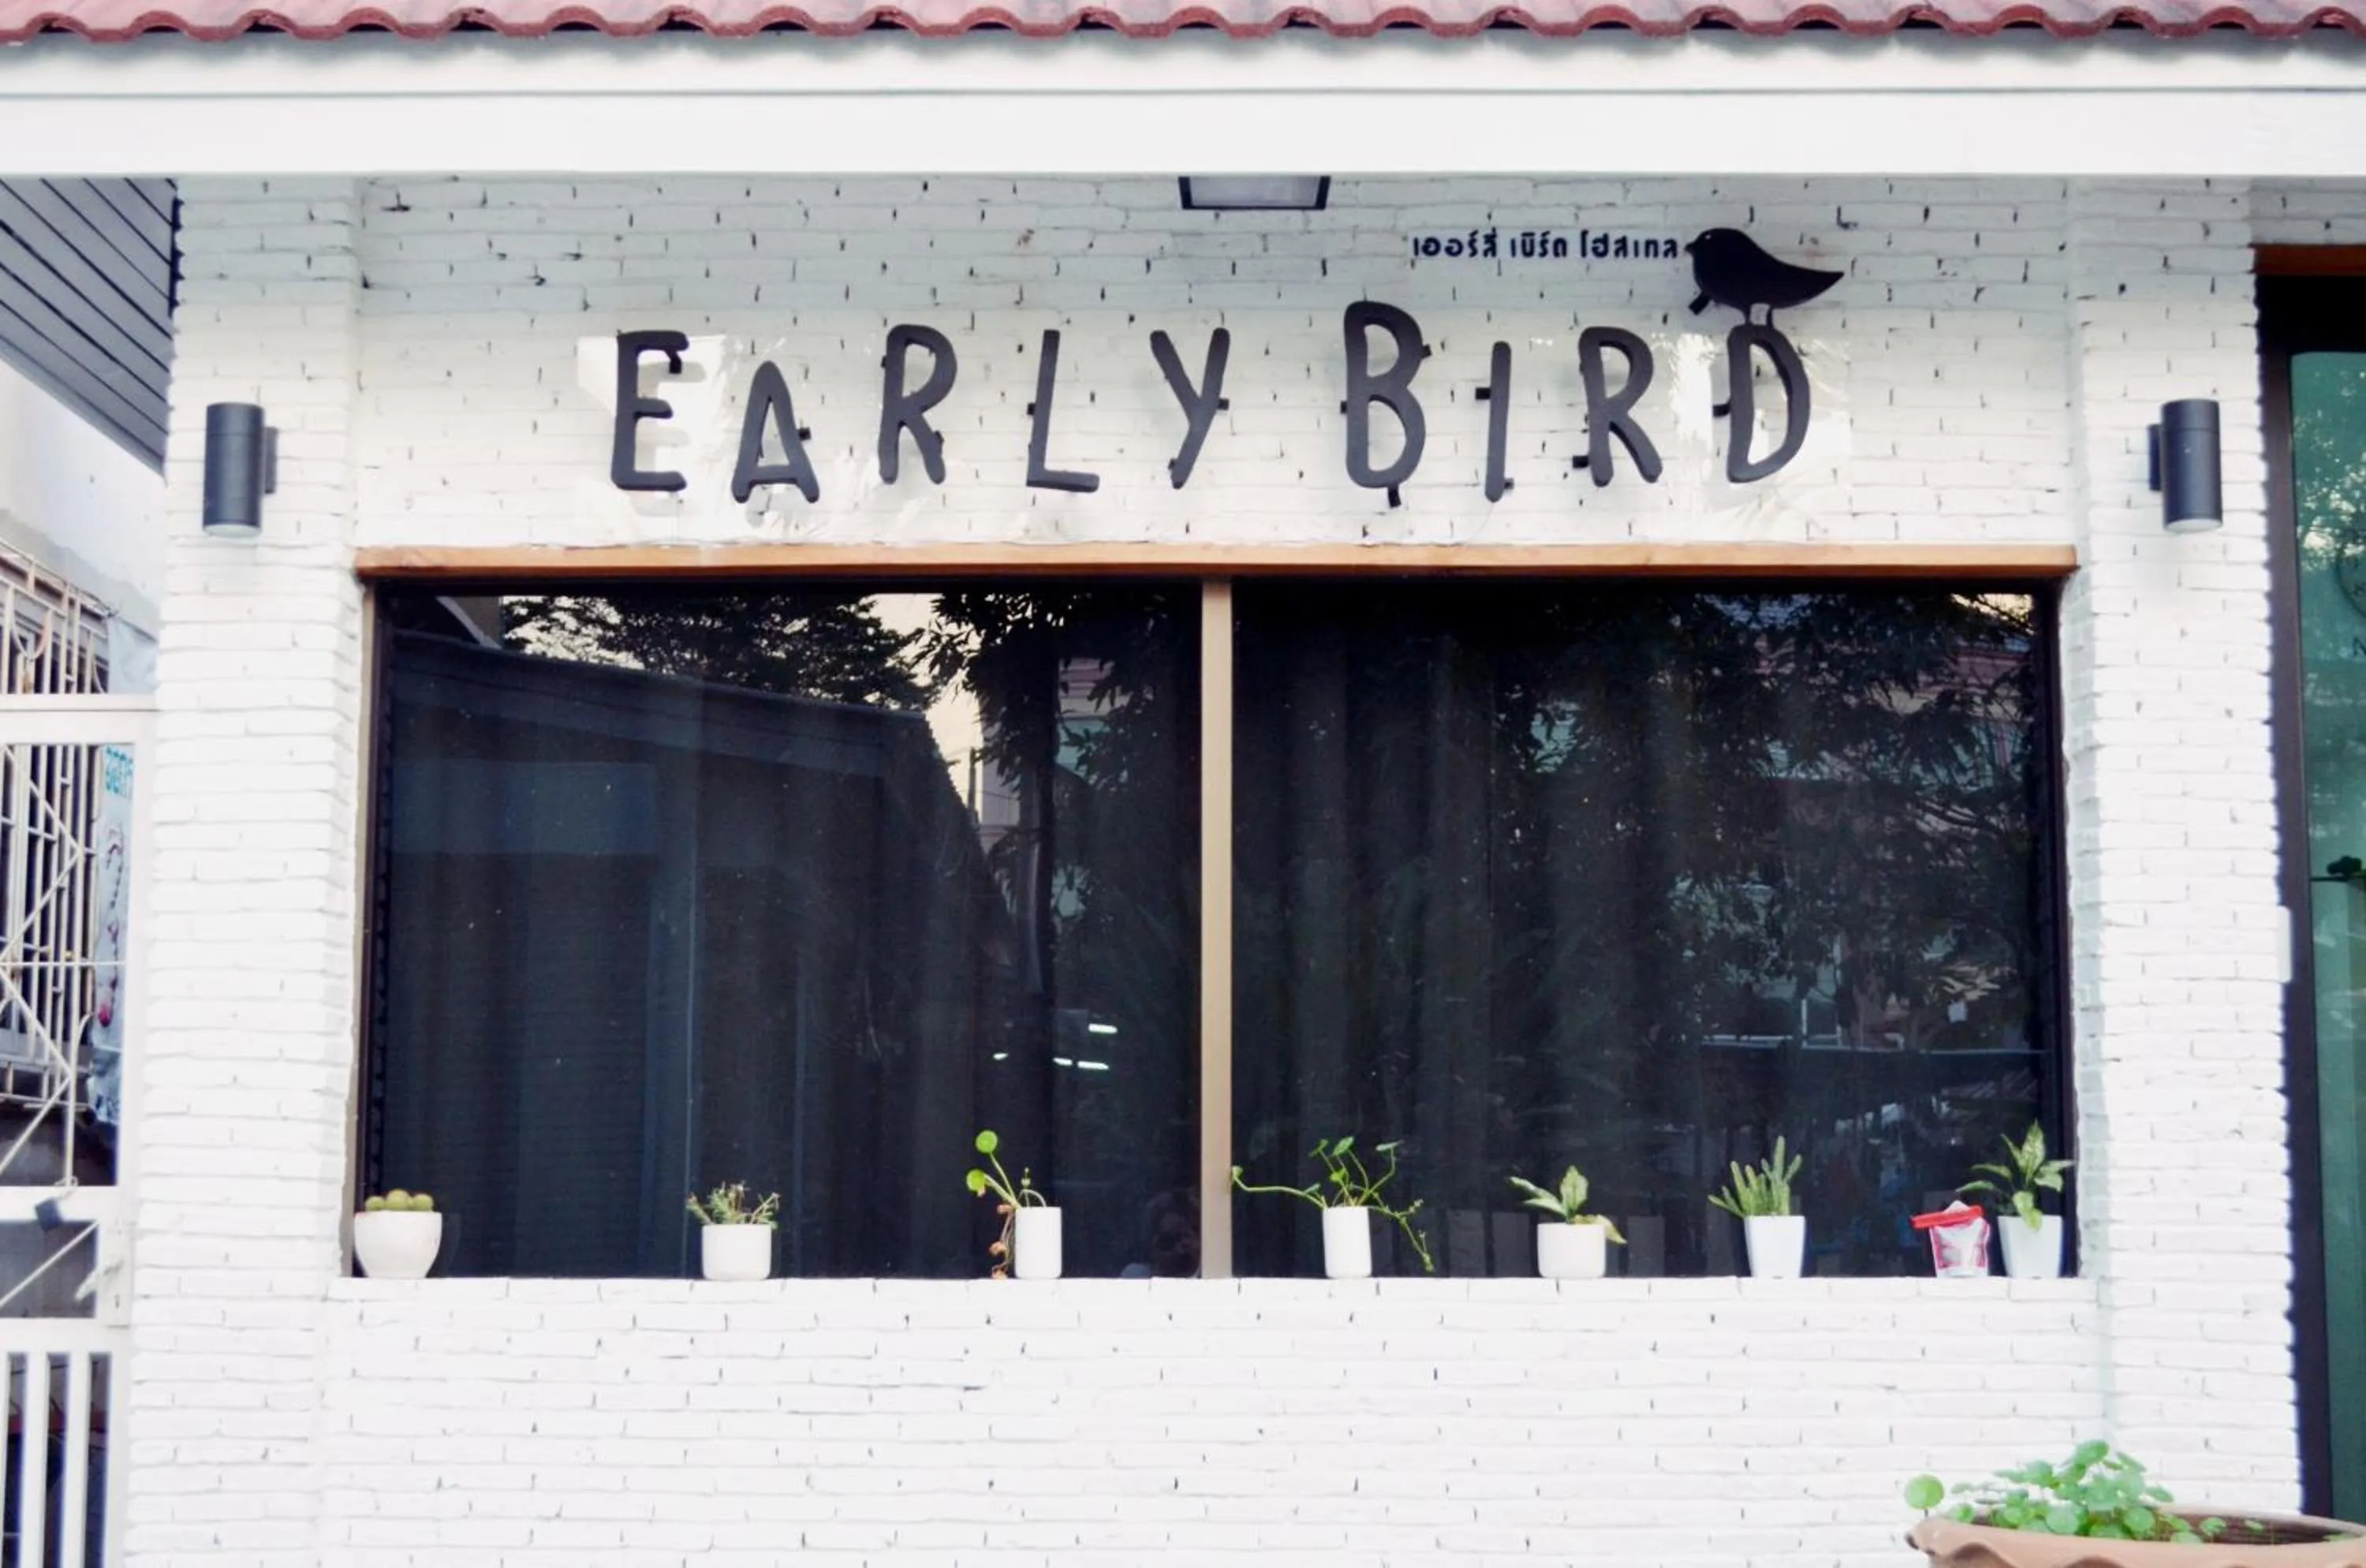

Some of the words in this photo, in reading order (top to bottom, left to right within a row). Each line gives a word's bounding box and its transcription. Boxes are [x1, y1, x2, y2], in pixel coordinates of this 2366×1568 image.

[1580, 229, 1678, 259] โฮสเทล
[610, 324, 1231, 503] EARLY
[1342, 300, 1812, 503] BIRD
